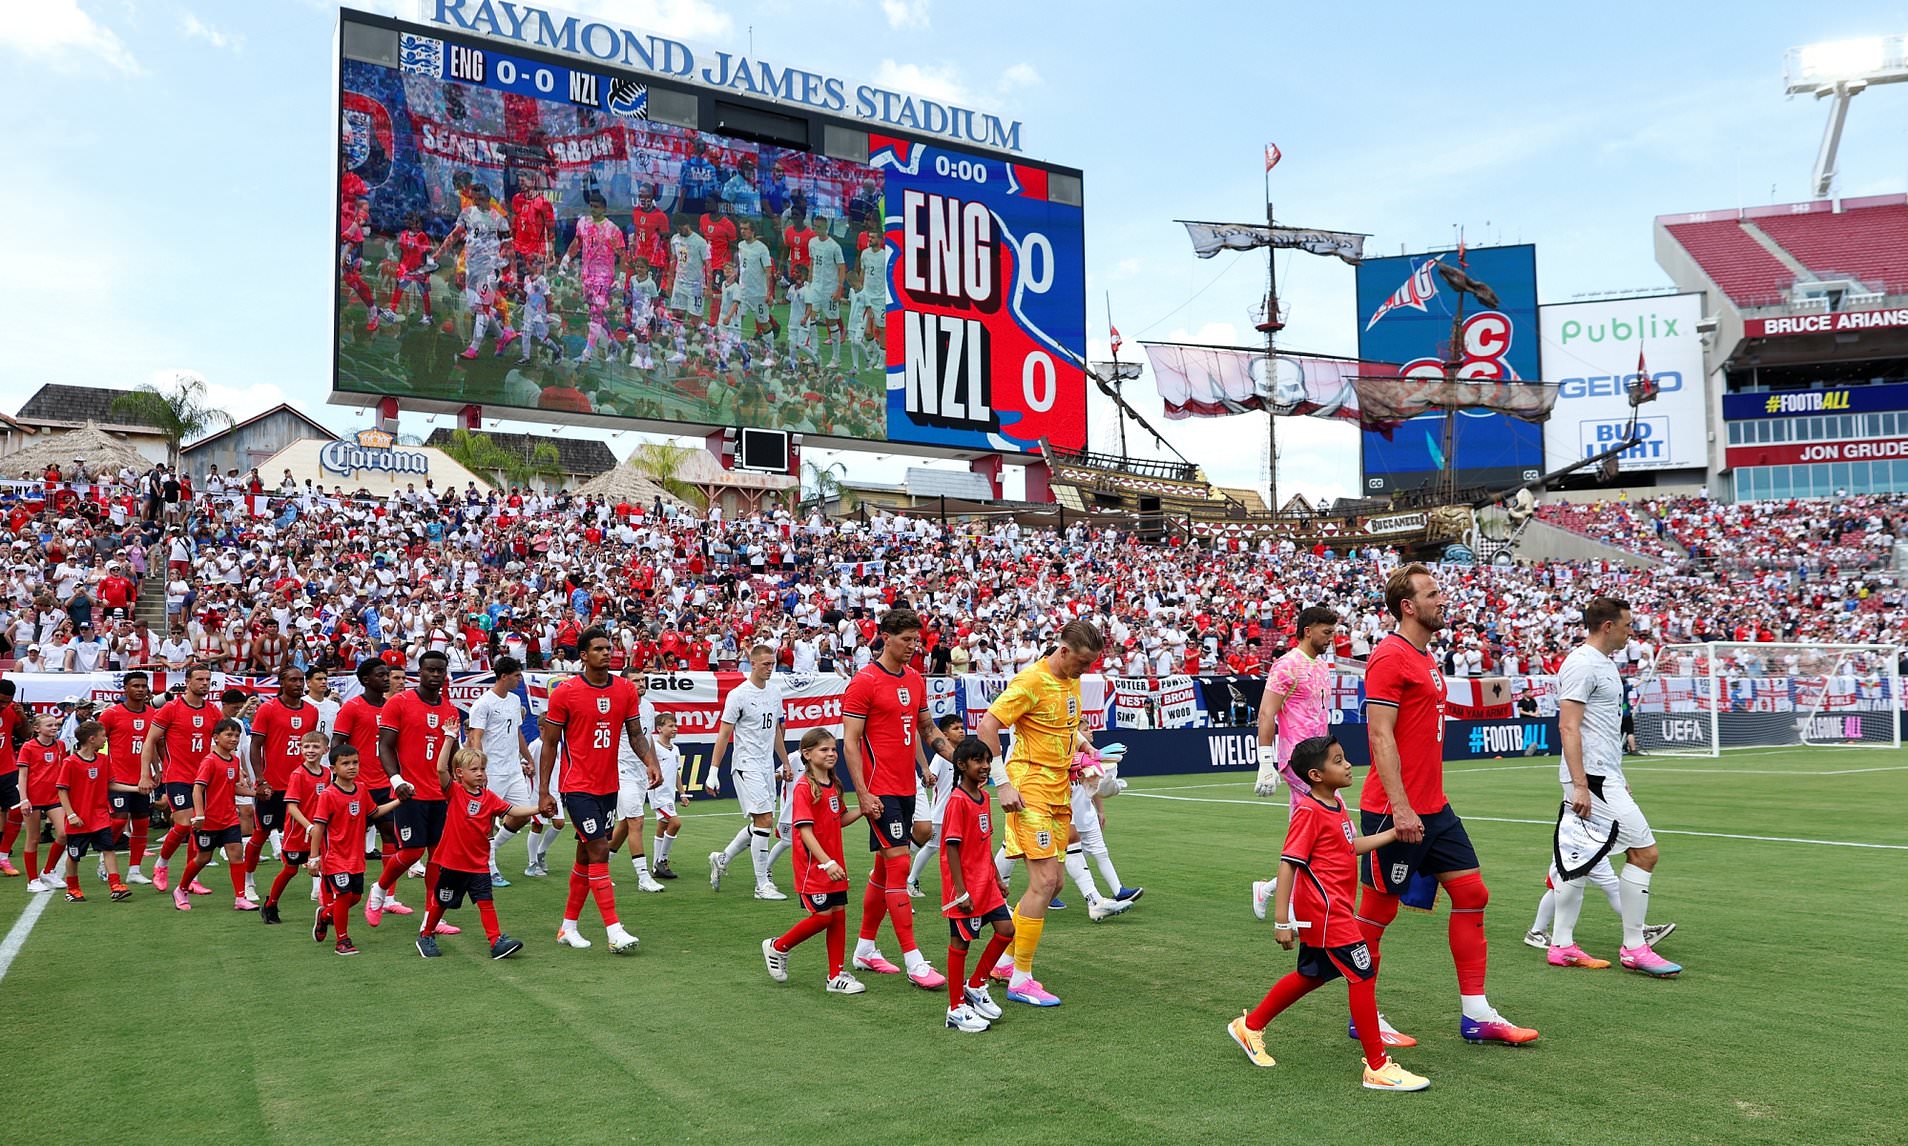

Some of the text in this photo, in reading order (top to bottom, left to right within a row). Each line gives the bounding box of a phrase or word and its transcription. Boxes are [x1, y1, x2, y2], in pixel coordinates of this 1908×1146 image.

[431, 0, 1023, 152] RAYMOND JAMES STADIUM
[450, 46, 484, 82] ENG
[569, 70, 599, 106] NZL
[935, 155, 987, 184] 0:00
[904, 189, 1055, 301] ENG 0
[1562, 314, 1679, 345] Publix
[1764, 310, 1908, 335] BRUCE ARIANS
[904, 310, 1057, 423] NZL 0
[1765, 391, 1850, 413] #FOOTBALL
[1596, 423, 1652, 442] BUD
[321, 440, 428, 477] Corona
[1800, 445, 1840, 461] JON
[1369, 479, 1383, 489] CC
[1524, 471, 1538, 481] CC
[448, 687, 488, 699] WIG
[934, 680, 945, 693] C
[1115, 679, 1146, 691] CUTLER
[1164, 689, 1194, 705] BROM
[762, 712, 773, 729] 16
[1168, 707, 1191, 720] WOOD
[1328, 709, 1344, 725] D
[506, 719, 512, 734] 7
[903, 724, 911, 746] 5
[1662, 720, 1703, 740] UEFA
[131, 740, 143, 754] 19
[191, 737, 203, 753] 14
[286, 740, 301, 756] 25
[594, 728, 611, 749] 26
[1468, 724, 1548, 753] #FOOTBALL
[425, 742, 434, 761] 6
[1208, 735, 1278, 766] WELC
